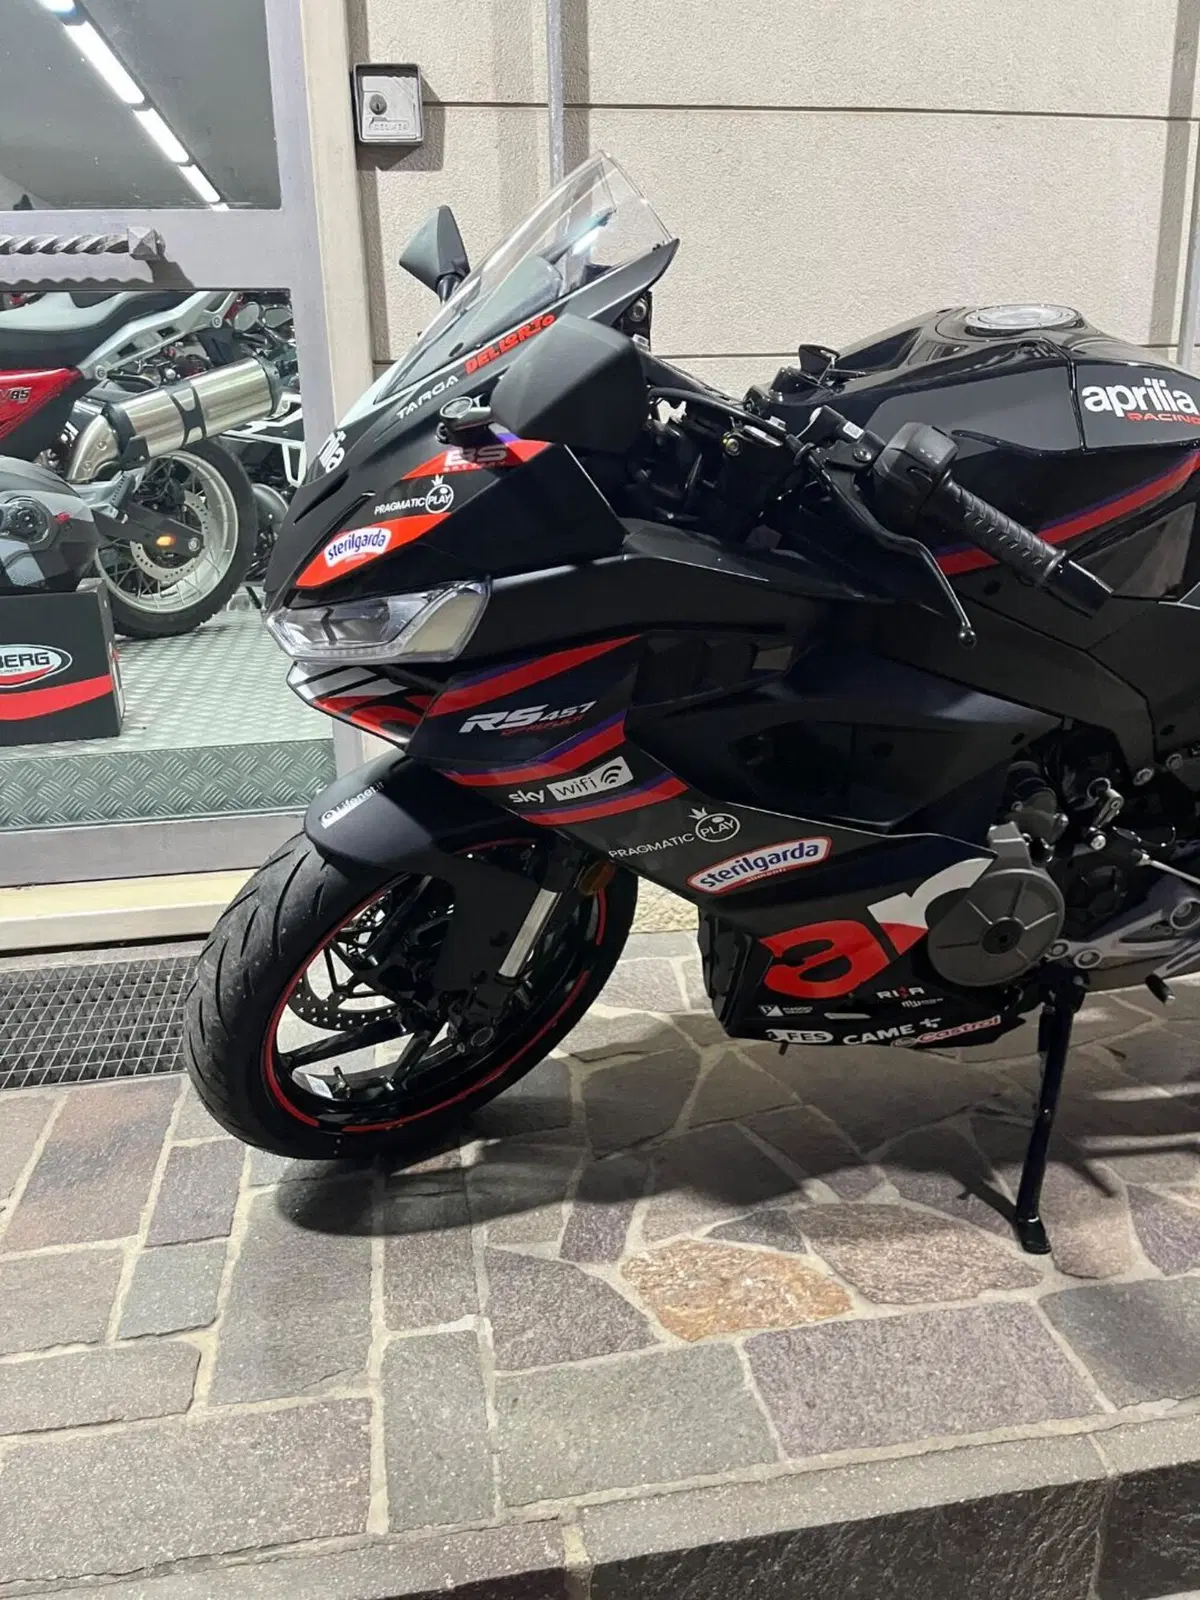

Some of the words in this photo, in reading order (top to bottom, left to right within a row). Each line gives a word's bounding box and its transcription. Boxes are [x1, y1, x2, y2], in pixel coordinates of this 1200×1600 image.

[1081, 377, 1200, 418] aprilia
[374, 496, 425, 515] PRAGMATIC
[427, 493, 451, 506] PLAY
[327, 529, 387, 561] sterilgarda
[458, 703, 549, 734] RS
[542, 700, 598, 721] 457
[508, 789, 548, 804] sky
[555, 776, 598, 797] wifi
[608, 833, 695, 859] PRAGMATIC
[700, 819, 736, 838] PLAY
[700, 842, 820, 888] sterilgarda
[843, 1024, 915, 1046] CAME
